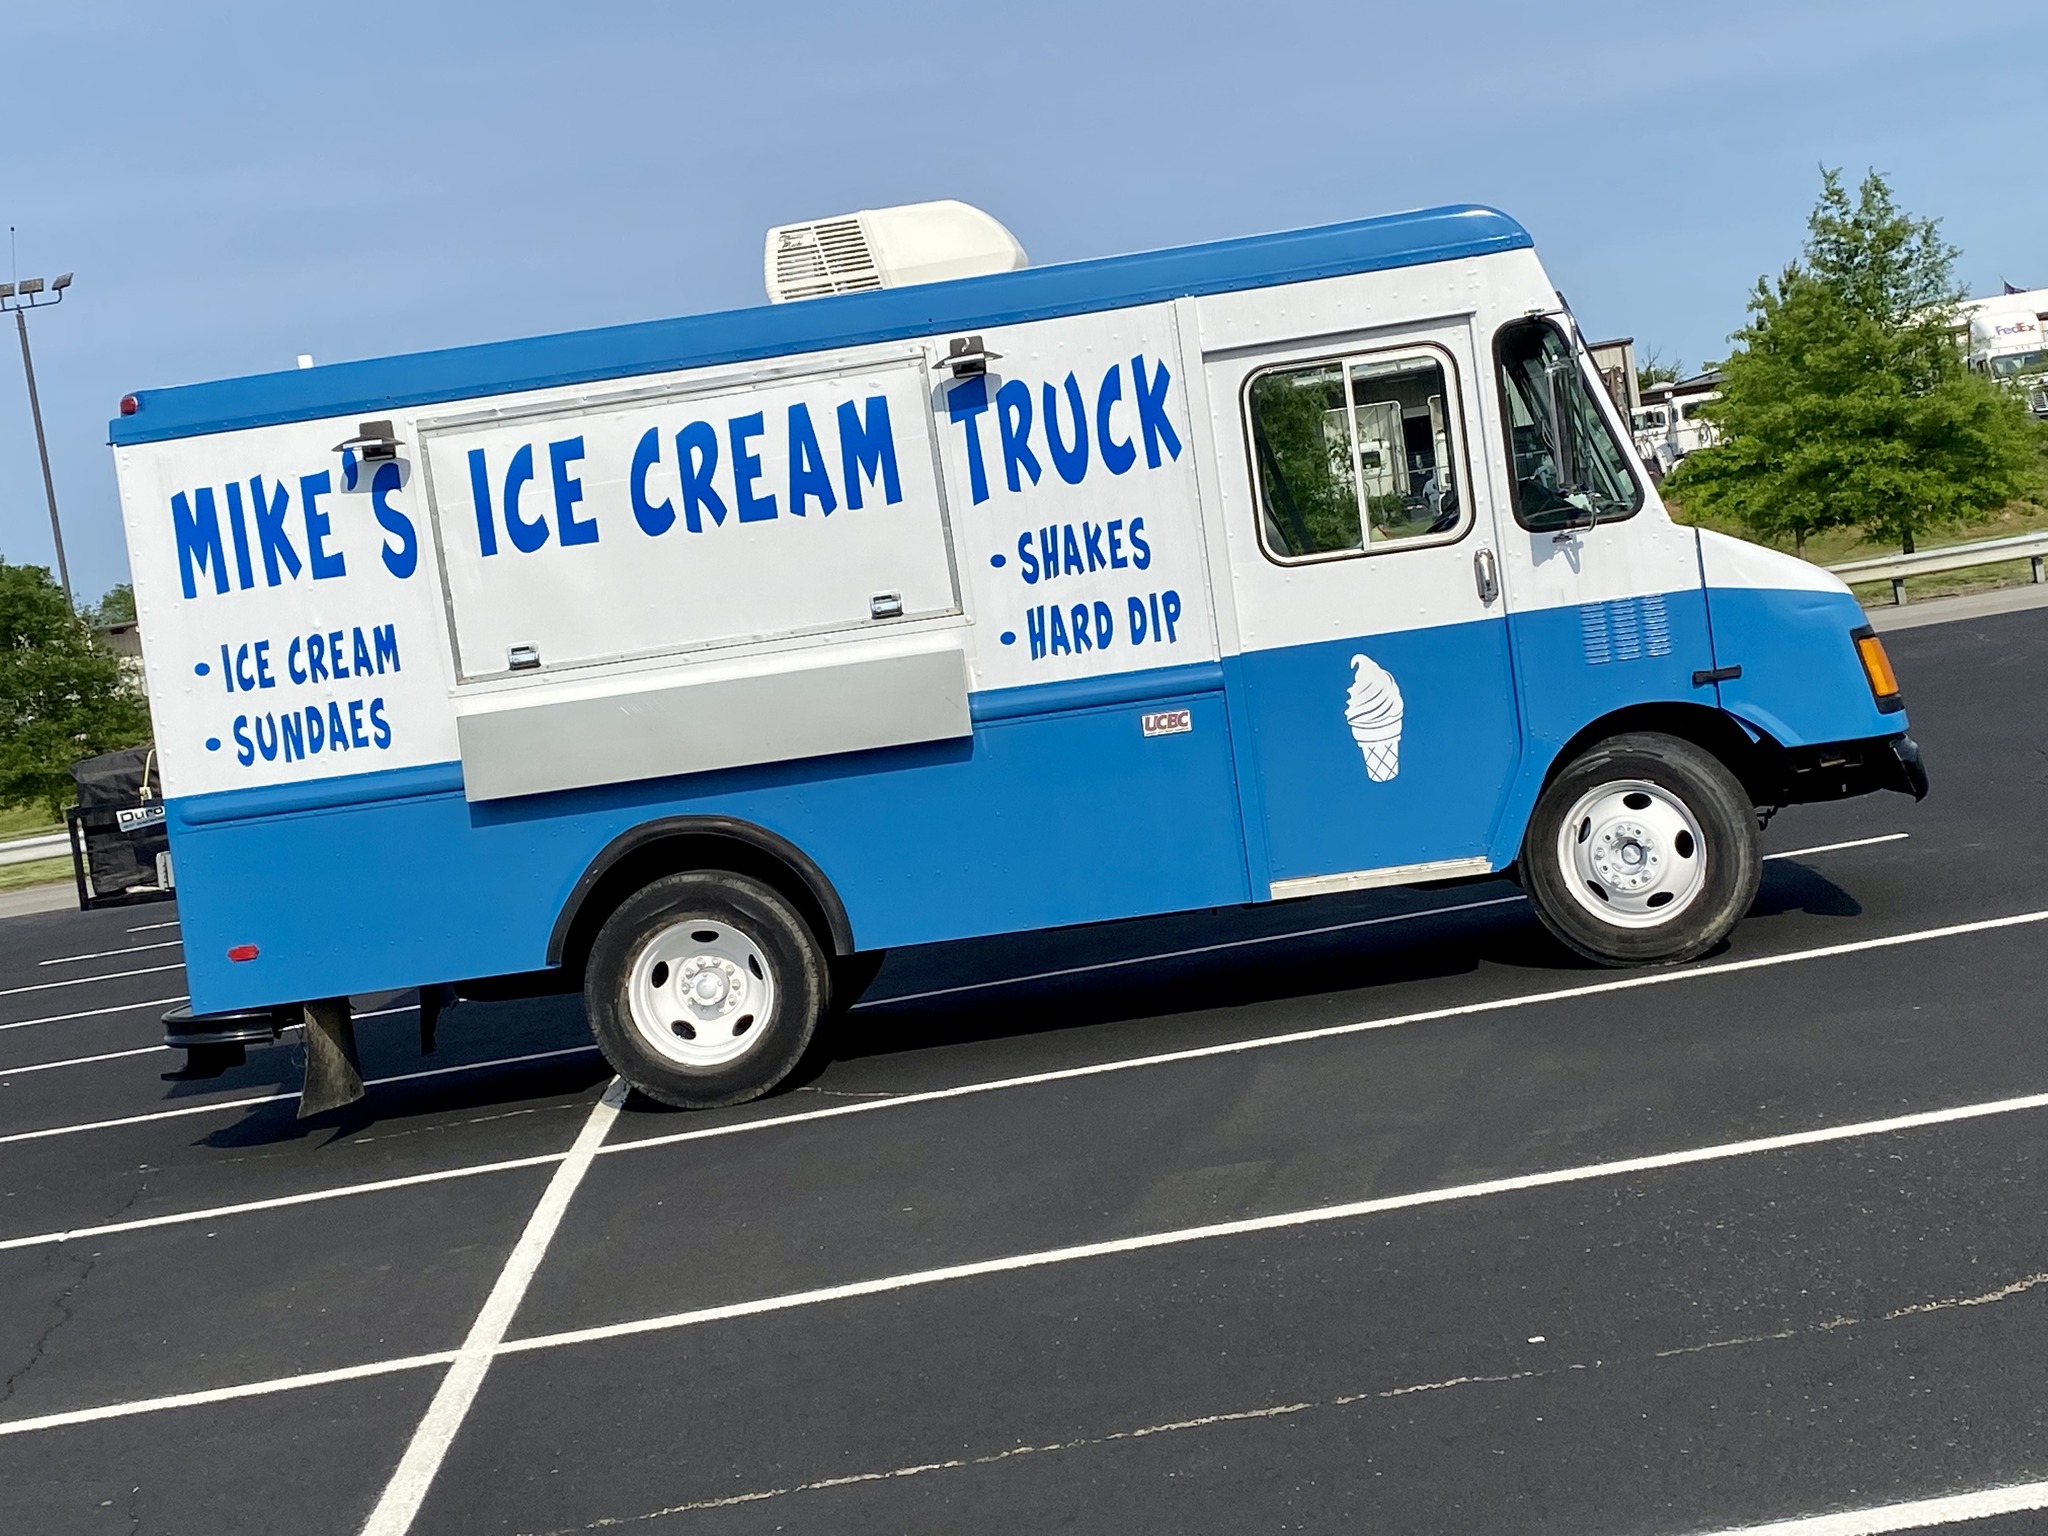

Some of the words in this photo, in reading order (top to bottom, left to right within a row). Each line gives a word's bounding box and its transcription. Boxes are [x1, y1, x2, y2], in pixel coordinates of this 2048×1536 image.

[1995, 322, 2036, 336] FedEx
[170, 446, 418, 600] MIKE'S
[467, 436, 600, 558] ICE
[629, 395, 904, 538] CREAM
[947, 353, 1183, 507] TRUCK
[1017, 516, 1151, 585] SHAKES
[220, 639, 276, 693] ICE
[287, 623, 402, 684] CREAM
[1026, 600, 1114, 661] HARD
[1127, 589, 1182, 646] DIP
[232, 697, 392, 767] SUNDAES
[1144, 711, 1189, 732] UCBC
